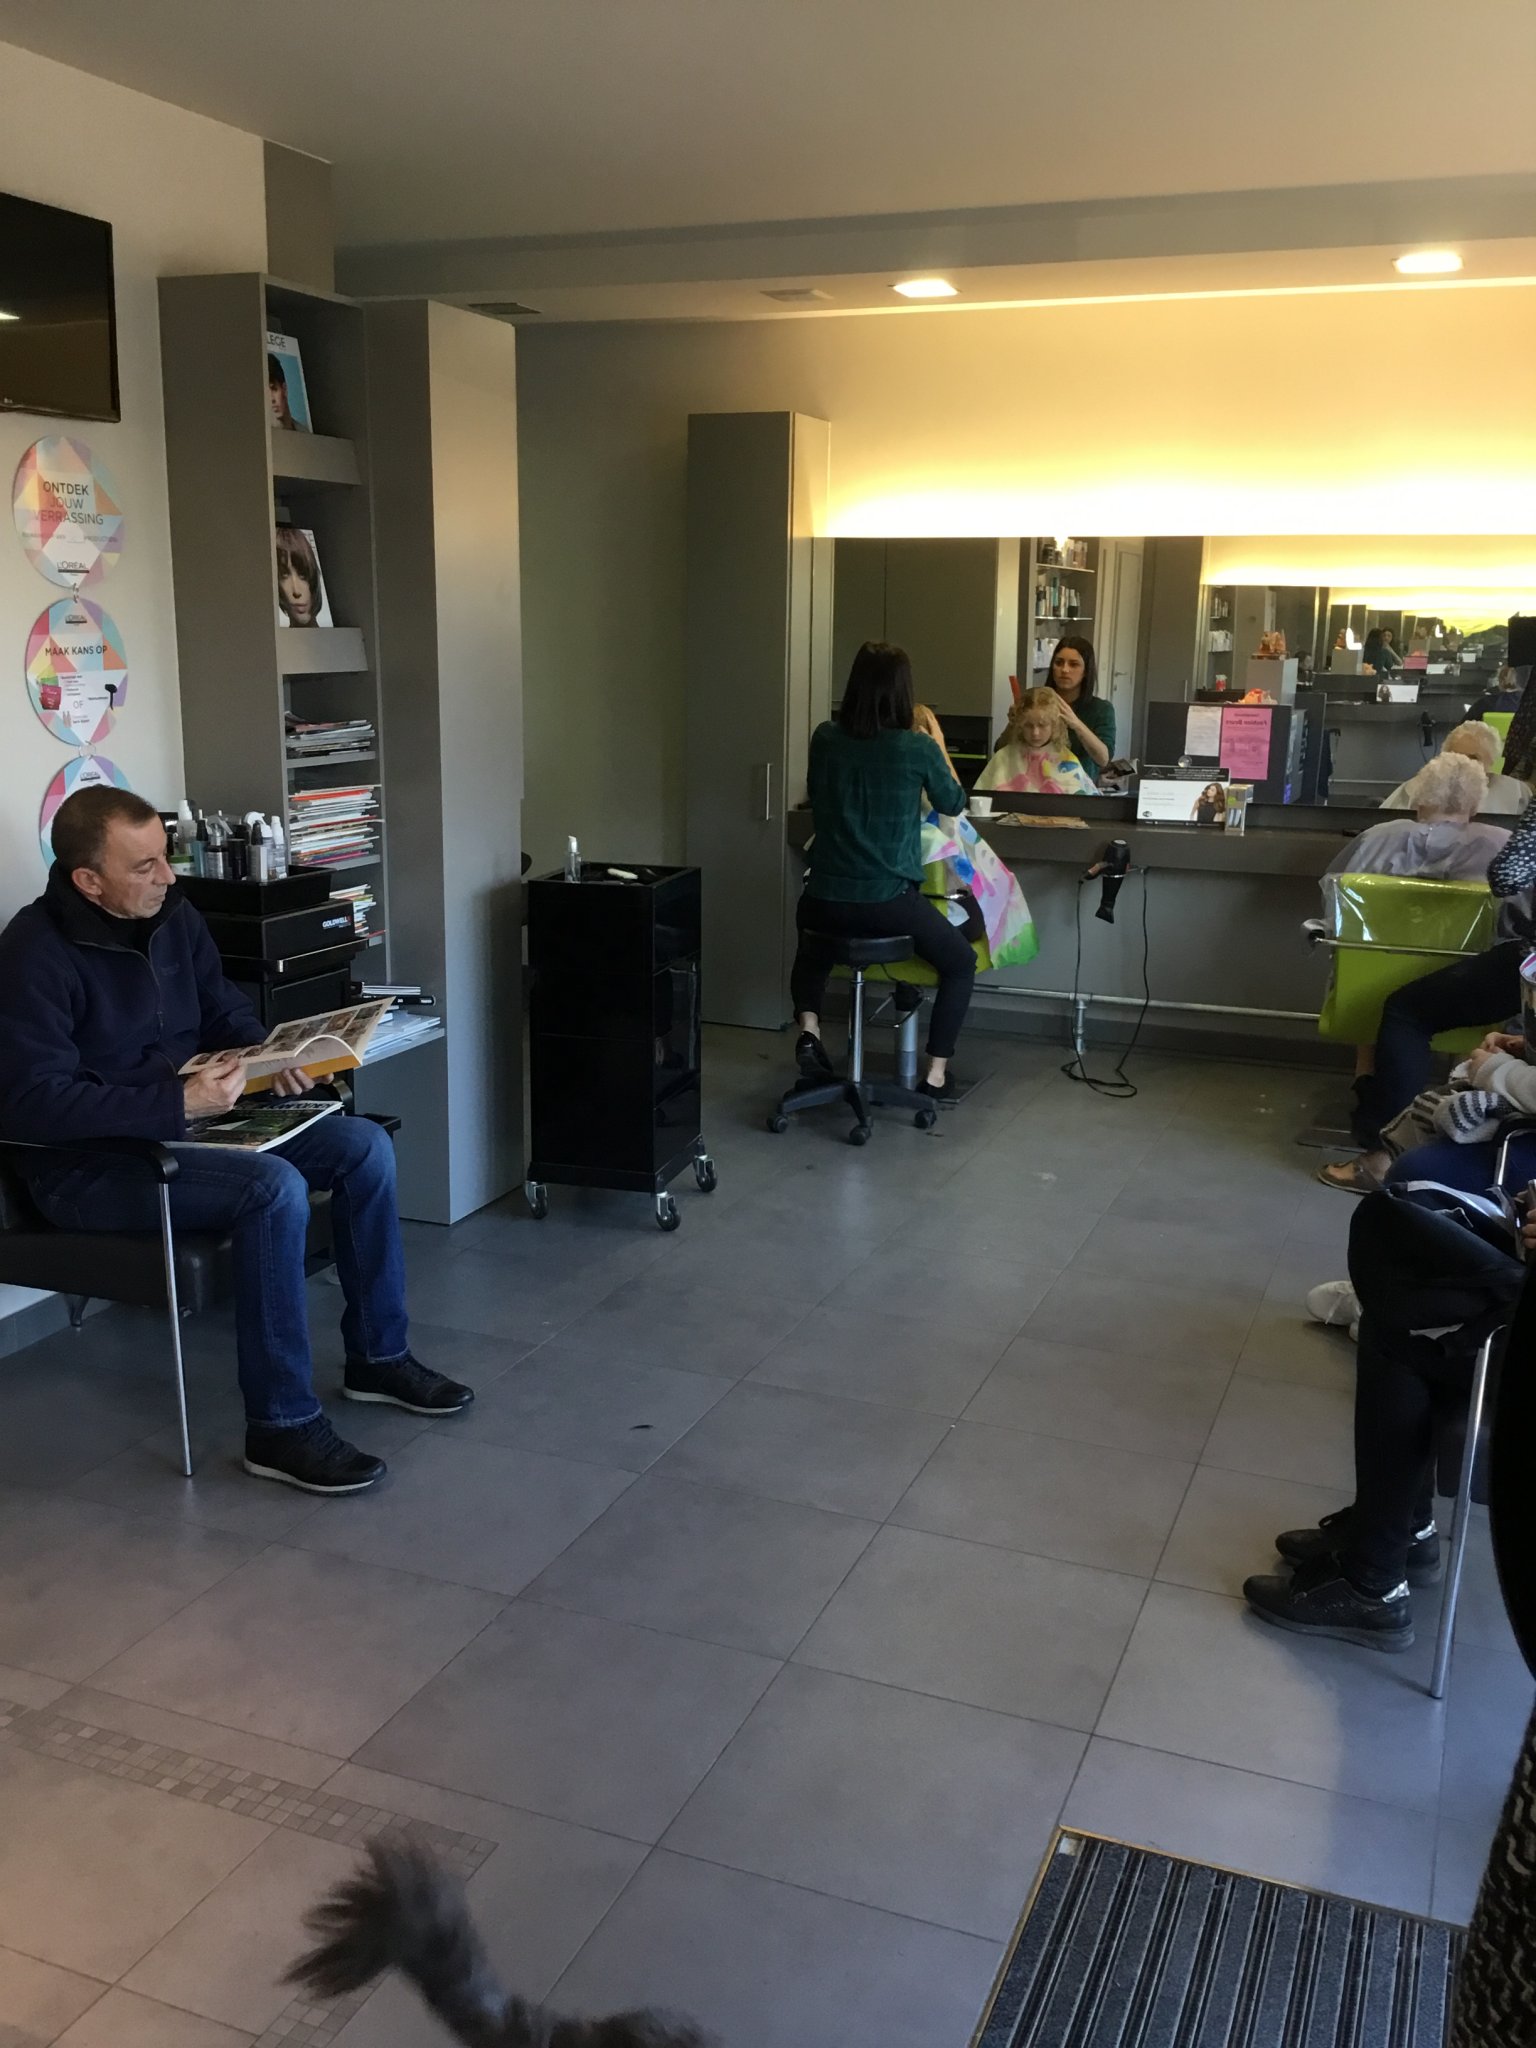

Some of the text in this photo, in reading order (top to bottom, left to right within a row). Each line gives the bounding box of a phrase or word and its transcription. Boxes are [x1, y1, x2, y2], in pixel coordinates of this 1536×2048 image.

[43, 481, 89, 495] ONTDEK
[50, 497, 84, 509] JOUW
[35, 511, 104, 525] VERRASSING
[45, 645, 108, 656] MAAK KANS OP
[73, 700, 83, 709] OF
